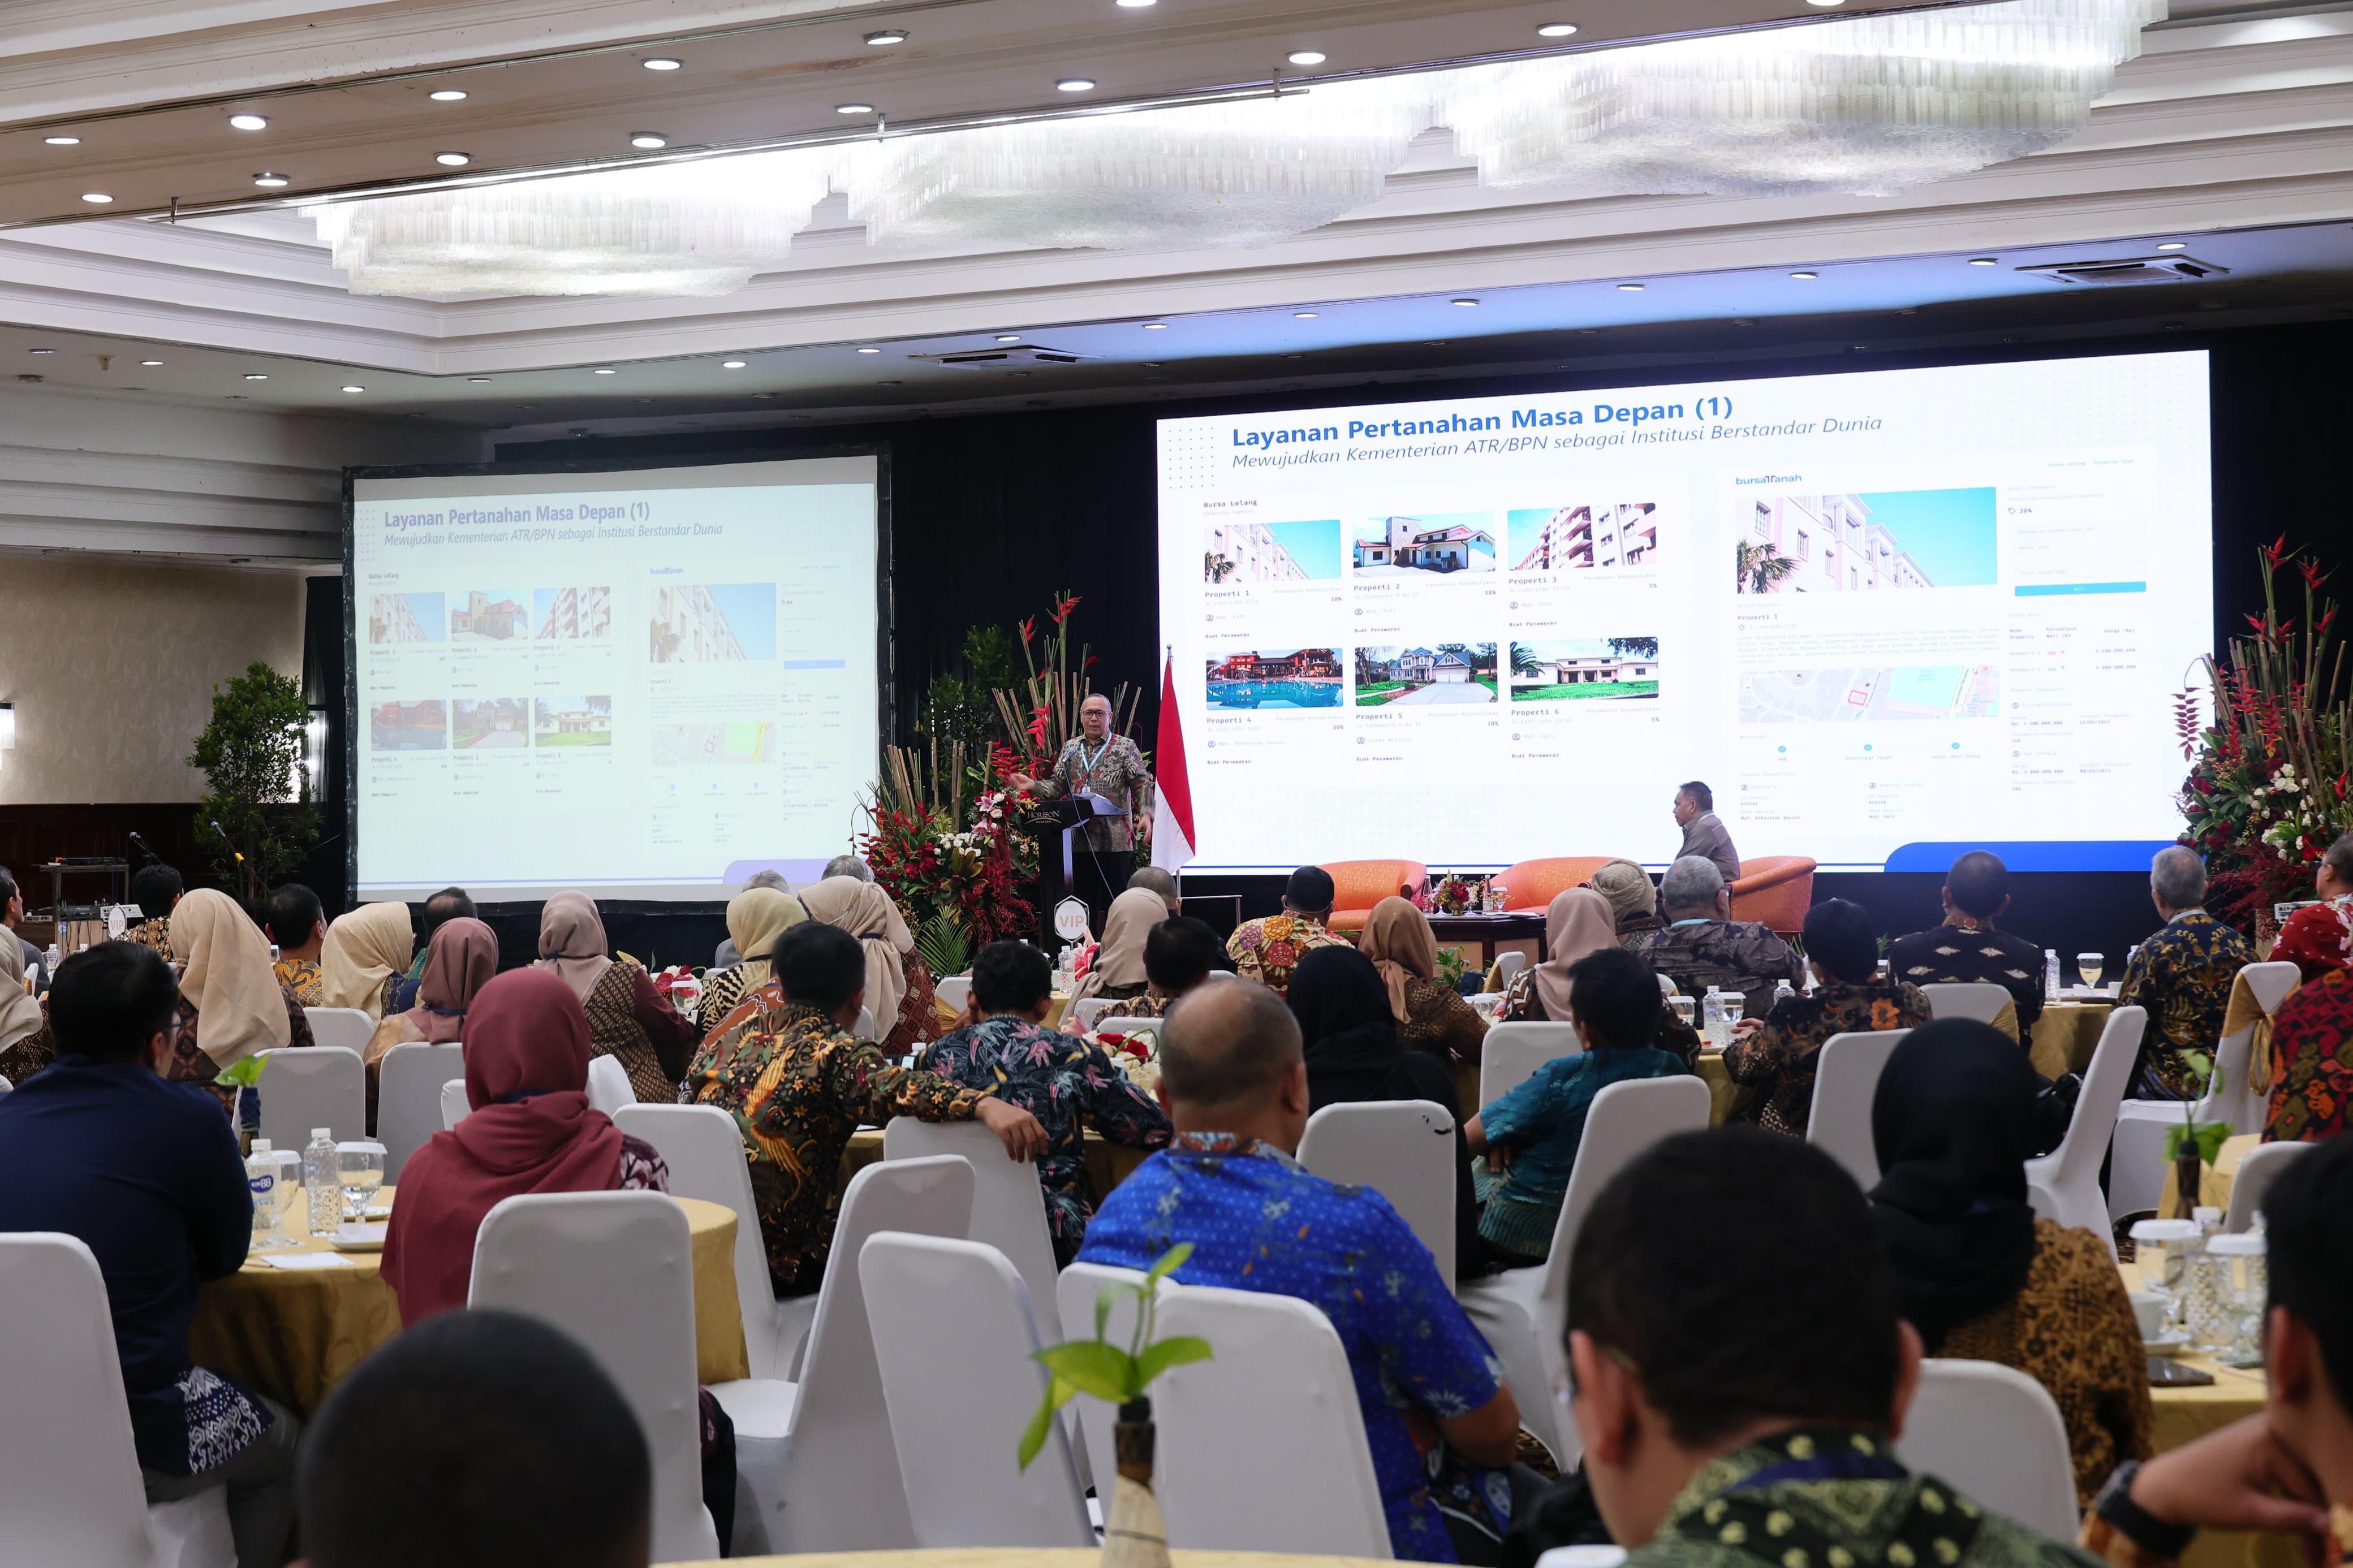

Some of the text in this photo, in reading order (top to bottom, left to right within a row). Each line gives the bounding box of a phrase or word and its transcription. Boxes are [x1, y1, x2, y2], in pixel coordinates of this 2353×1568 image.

[1233, 396, 1733, 451] Layanan Pertanahan Masa Depan (1)
[1232, 416, 1882, 469] Mewujudkan Kementerian ATR/BPN sebagai Institusi Berstandar Dunia
[385, 502, 649, 531] Layanan Pertanahan Masa Depan (1)
[384, 522, 723, 548] Mewujudkan Kementerian ATR/BPN sebagai Institusi Berstandar Dunia
[1059, 914, 1084, 928] VIP
